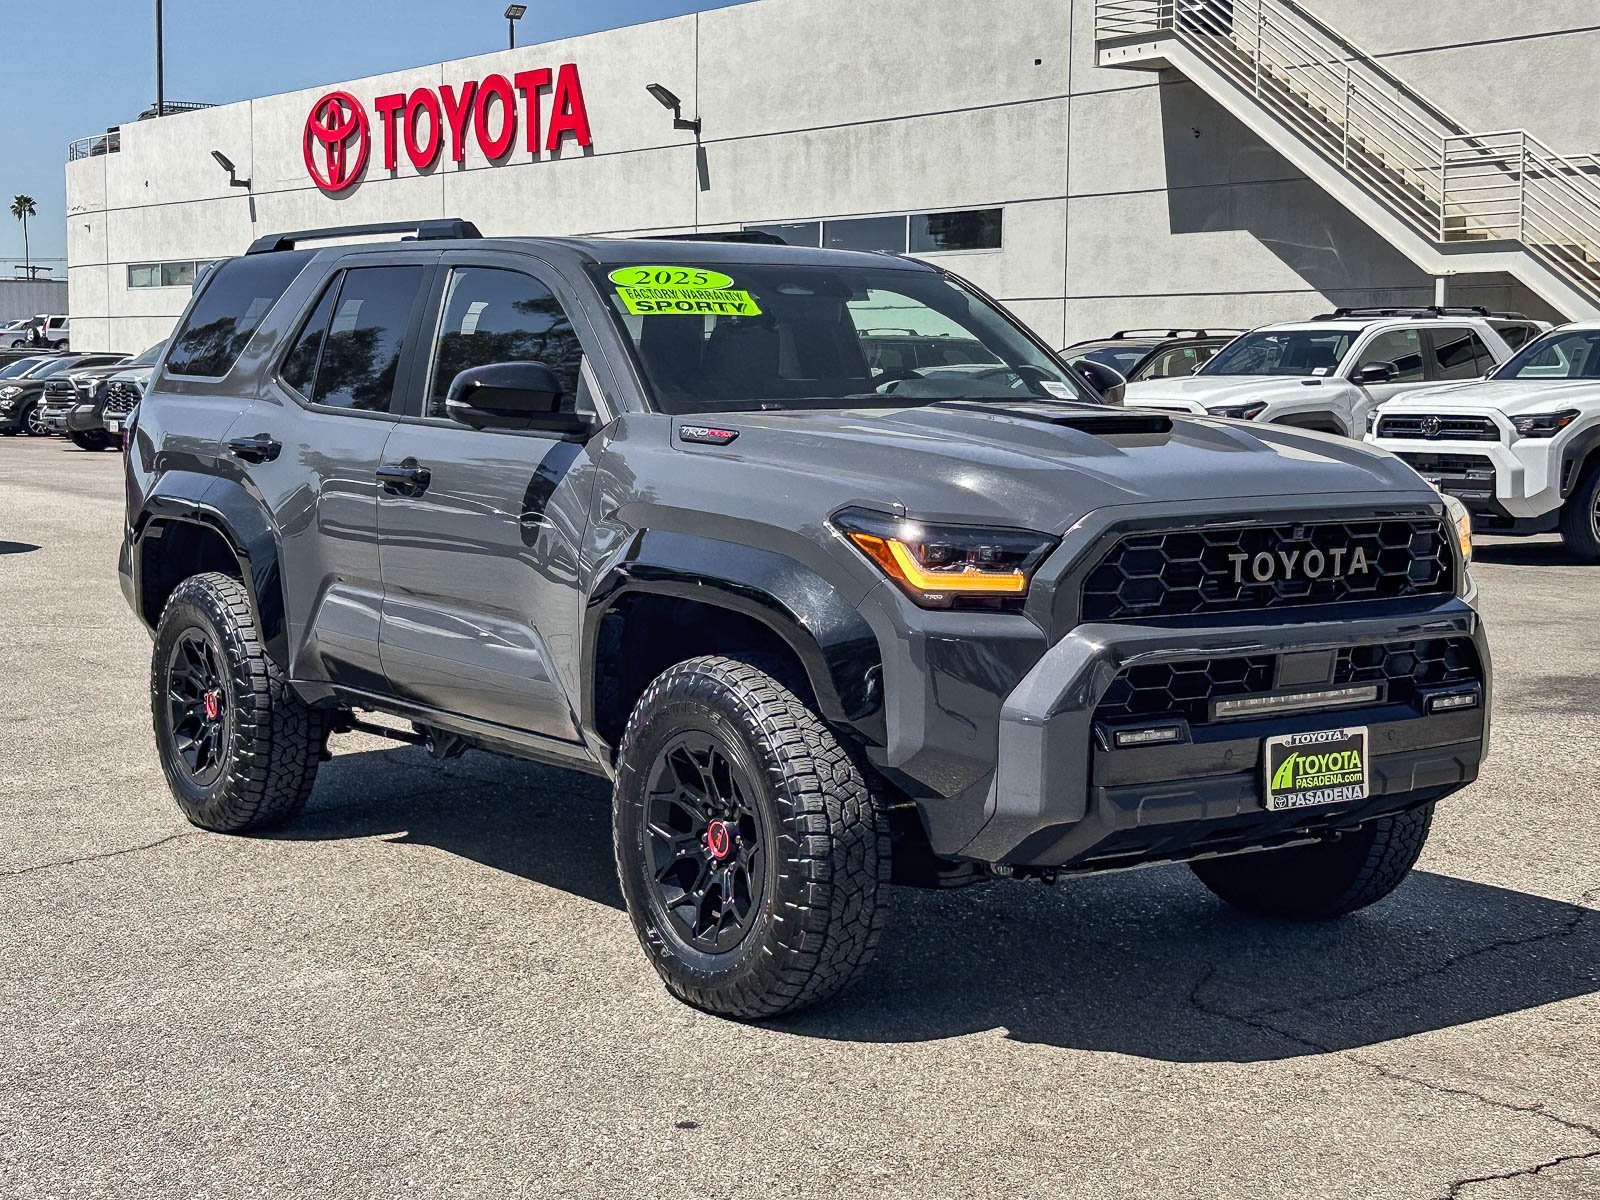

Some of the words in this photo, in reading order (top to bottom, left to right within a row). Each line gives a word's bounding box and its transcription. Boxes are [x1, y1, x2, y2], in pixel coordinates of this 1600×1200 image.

[375, 63, 592, 170] TOYOTA
[634, 270, 708, 286] 2025
[625, 288, 677, 300] FACTORY
[678, 289, 743, 302] WARRANTY
[635, 300, 746, 314] SPORTY
[1228, 546, 1369, 583] TOYOTA
[1293, 732, 1342, 744] TOYOTA
[1296, 750, 1362, 775] TOYOTA
[1296, 773, 1362, 788] PASADENA.com
[1288, 785, 1362, 806] PASADENA
